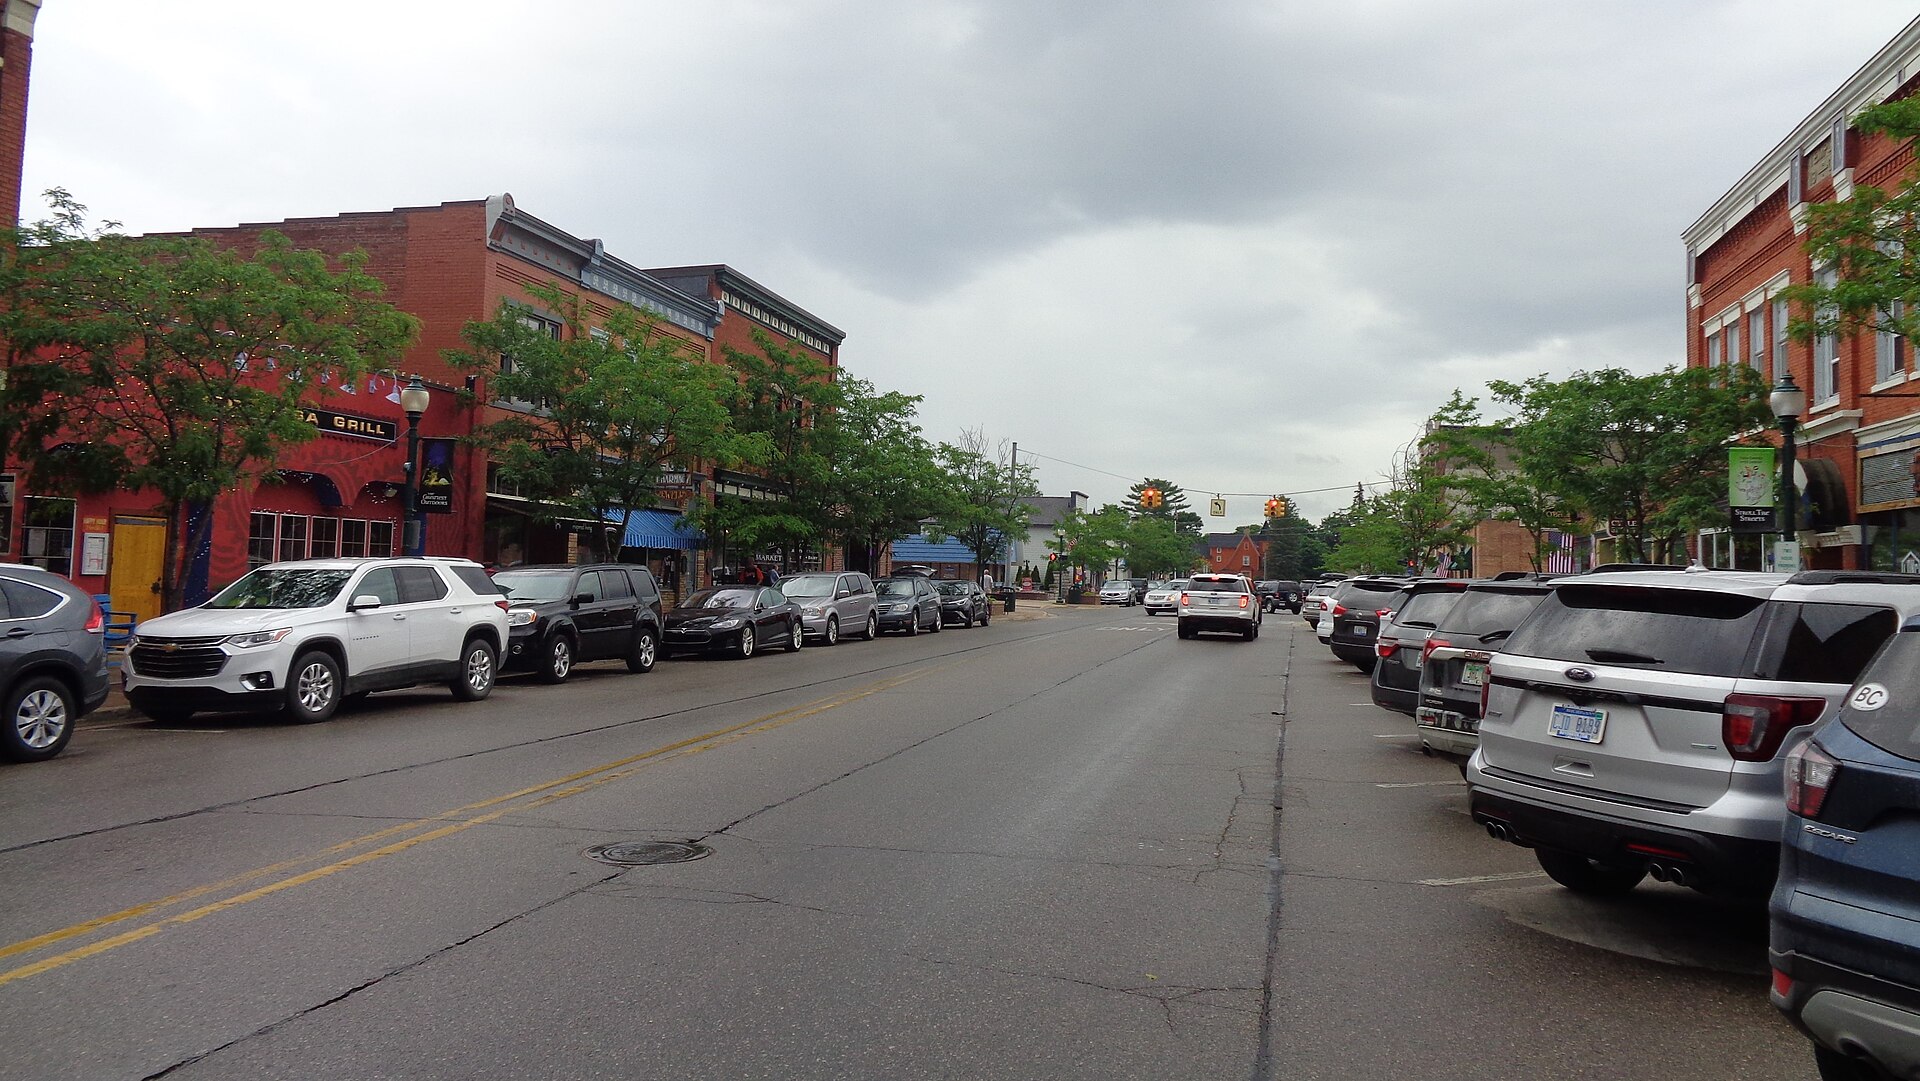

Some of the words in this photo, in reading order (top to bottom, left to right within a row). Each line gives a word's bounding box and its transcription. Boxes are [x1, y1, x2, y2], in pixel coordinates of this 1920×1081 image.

[333, 416, 385, 435] GRILL
[755, 554, 782, 562] MARKET
[1464, 650, 1490, 659] GMC
[1854, 687, 1883, 705] BC
[1804, 825, 1857, 844] ESCAPE
